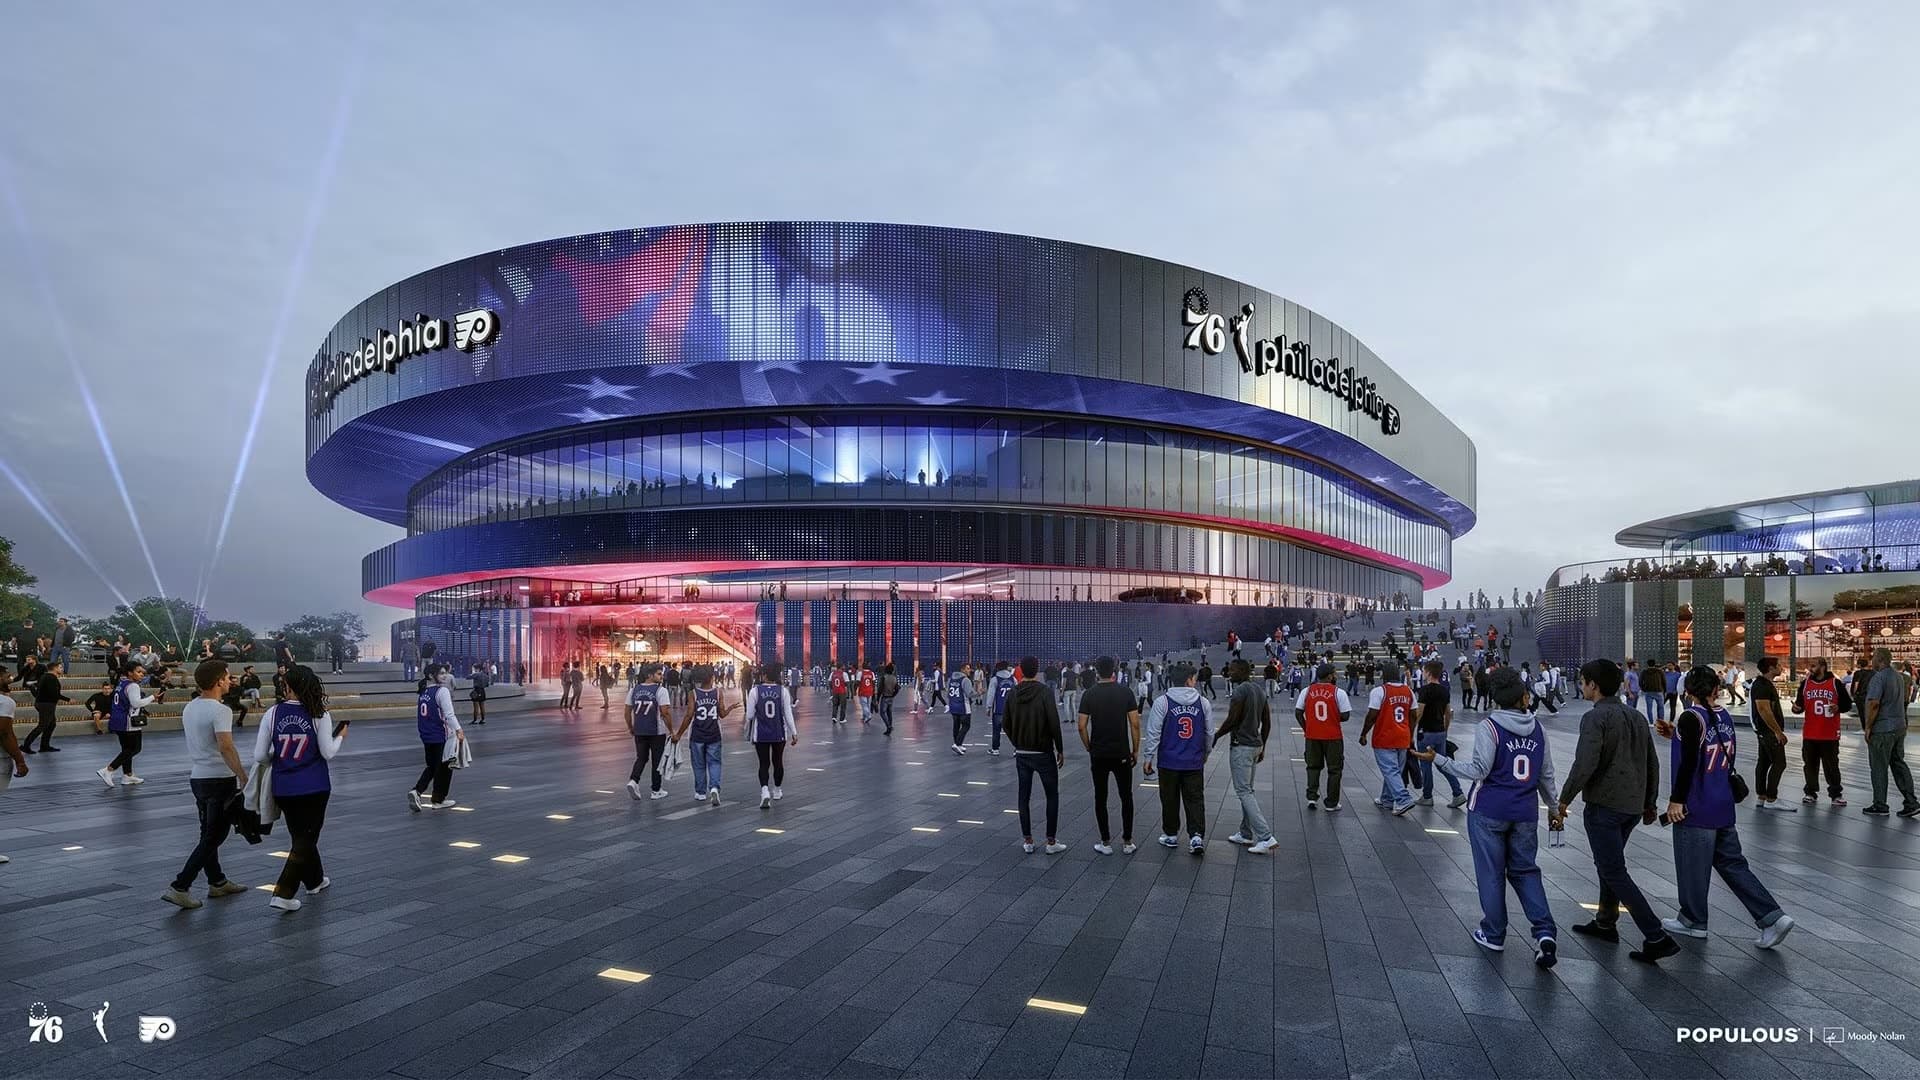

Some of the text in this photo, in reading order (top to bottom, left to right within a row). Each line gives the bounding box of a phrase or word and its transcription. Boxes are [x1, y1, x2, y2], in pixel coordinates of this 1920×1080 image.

[1186, 308, 1226, 354] 76
[1258, 335, 1386, 421] philadelphia
[113, 693, 119, 705] 0
[949, 687, 960, 697] 34
[1000, 687, 1011, 697] 7
[1806, 689, 1834, 701] SIXERS
[420, 702, 428, 716] 0
[634, 700, 653, 716] 77
[696, 705, 718, 721] 34
[765, 700, 776, 718] 0
[1170, 705, 1200, 717] IVERSON
[1314, 700, 1328, 721] 0
[1394, 706, 1405, 723] 6
[1178, 716, 1193, 739] 3
[278, 733, 308, 758] 77
[1505, 738, 1538, 753] MAXEY
[1513, 754, 1530, 780] 0
